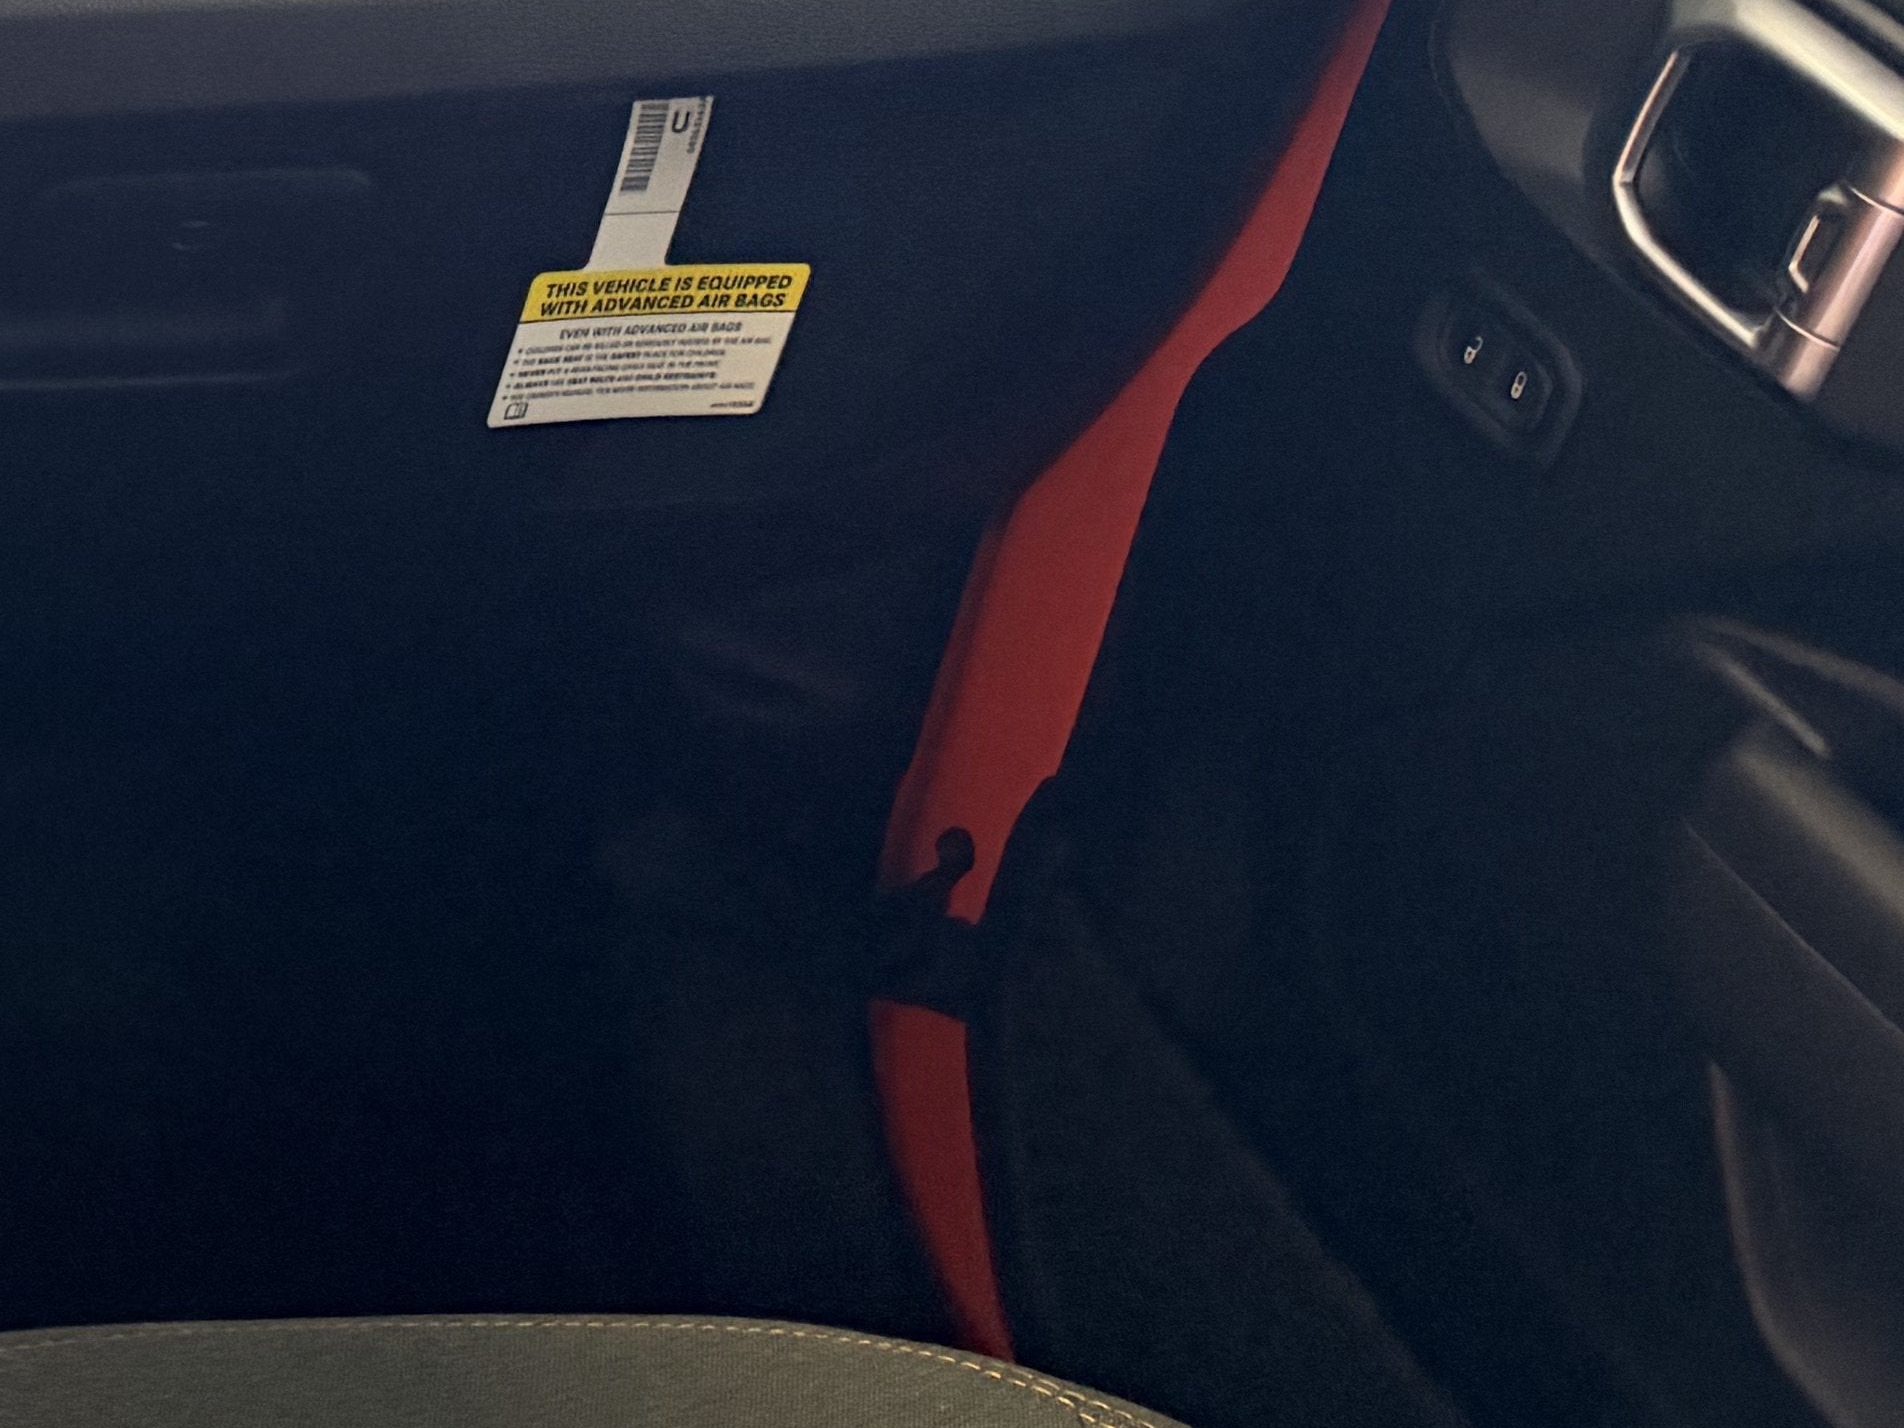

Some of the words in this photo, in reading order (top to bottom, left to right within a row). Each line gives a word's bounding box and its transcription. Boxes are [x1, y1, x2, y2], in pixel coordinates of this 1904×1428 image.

[672, 109, 690, 133] U
[546, 280, 589, 299] THIS
[592, 276, 671, 295] VEHICLE
[674, 276, 693, 292] IS
[696, 274, 793, 291] EQUIPPED
[540, 298, 589, 317] WITH
[590, 293, 694, 313] ADVANCED
[697, 292, 731, 308] AIR
[733, 291, 786, 308] BAGS
[559, 326, 590, 340] EVEN
[591, 324, 621, 338] WITH
[623, 323, 686, 336] ADVANCED
[688, 322, 709, 333] AIR
[710, 321, 743, 334] BAGS
